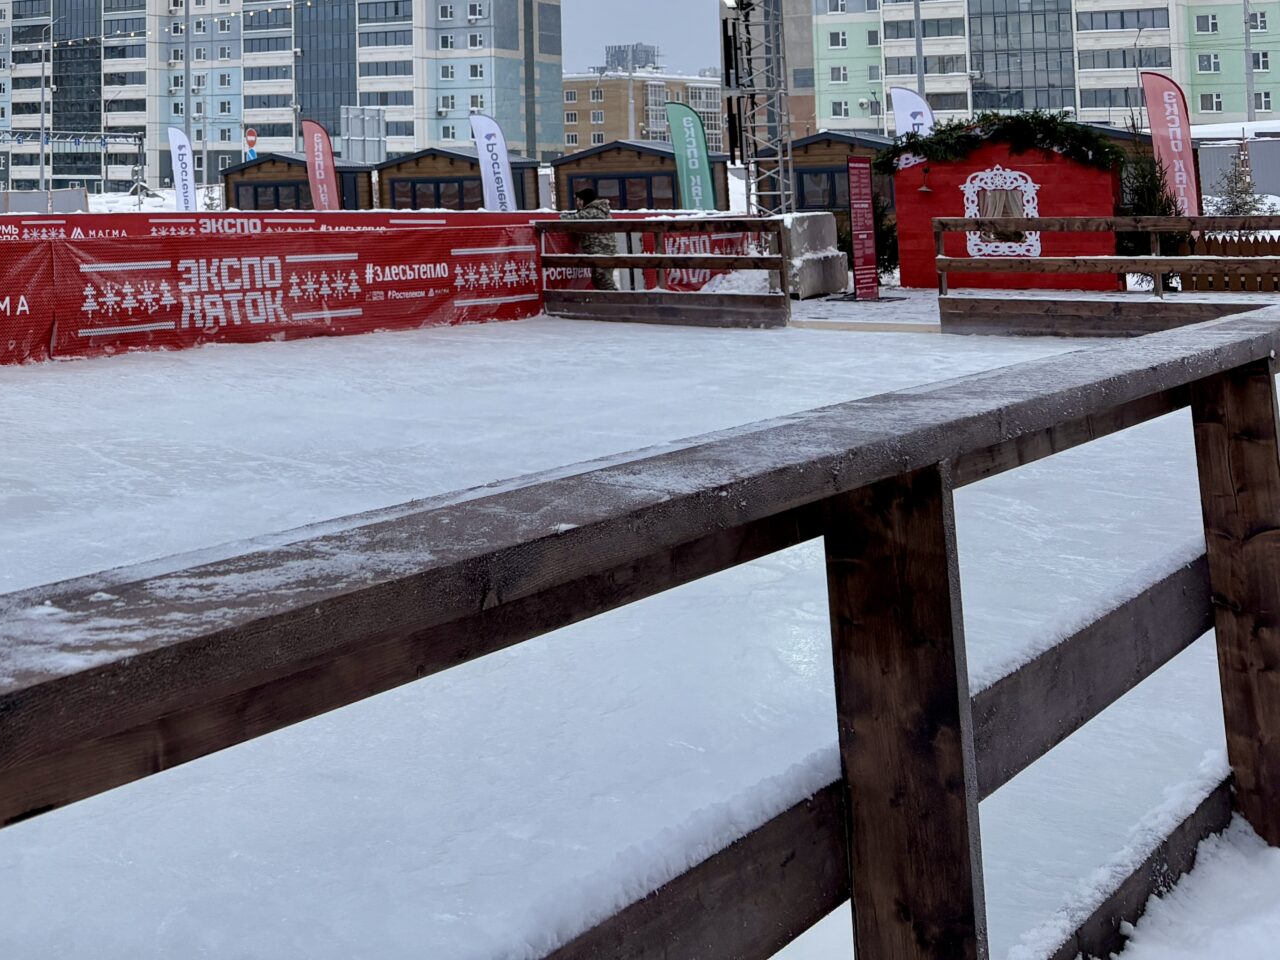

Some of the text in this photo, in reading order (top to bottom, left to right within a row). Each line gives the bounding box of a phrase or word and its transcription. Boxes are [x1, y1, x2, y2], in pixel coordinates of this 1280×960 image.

[88, 229, 128, 239] МАГМА
[199, 219, 262, 234] ЭКСПО
[177, 256, 283, 293] ЭКСПО
[180, 290, 289, 329] КАТОК
